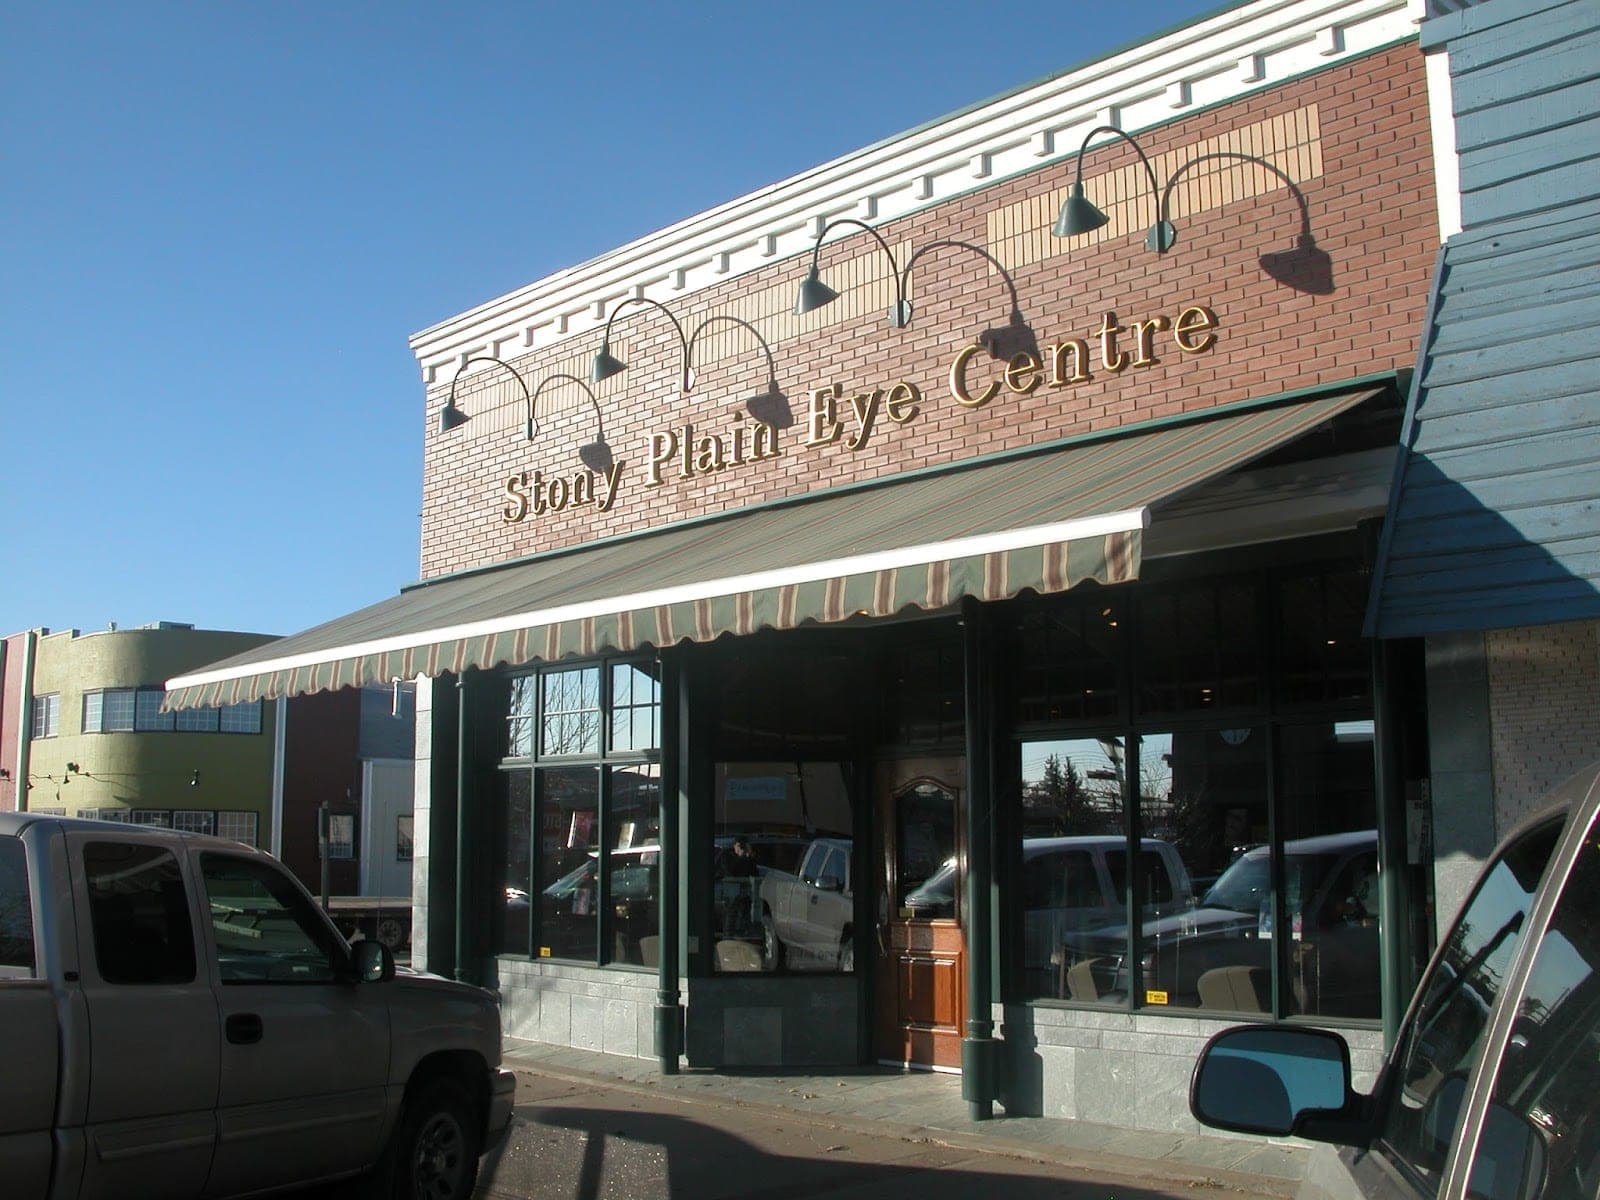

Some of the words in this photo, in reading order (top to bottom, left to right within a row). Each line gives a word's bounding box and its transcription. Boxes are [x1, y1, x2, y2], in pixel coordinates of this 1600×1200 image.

[502, 459, 625, 523] Stony
[644, 410, 781, 488] Plain
[805, 382, 922, 451] Eye
[949, 305, 1219, 408] Centre
